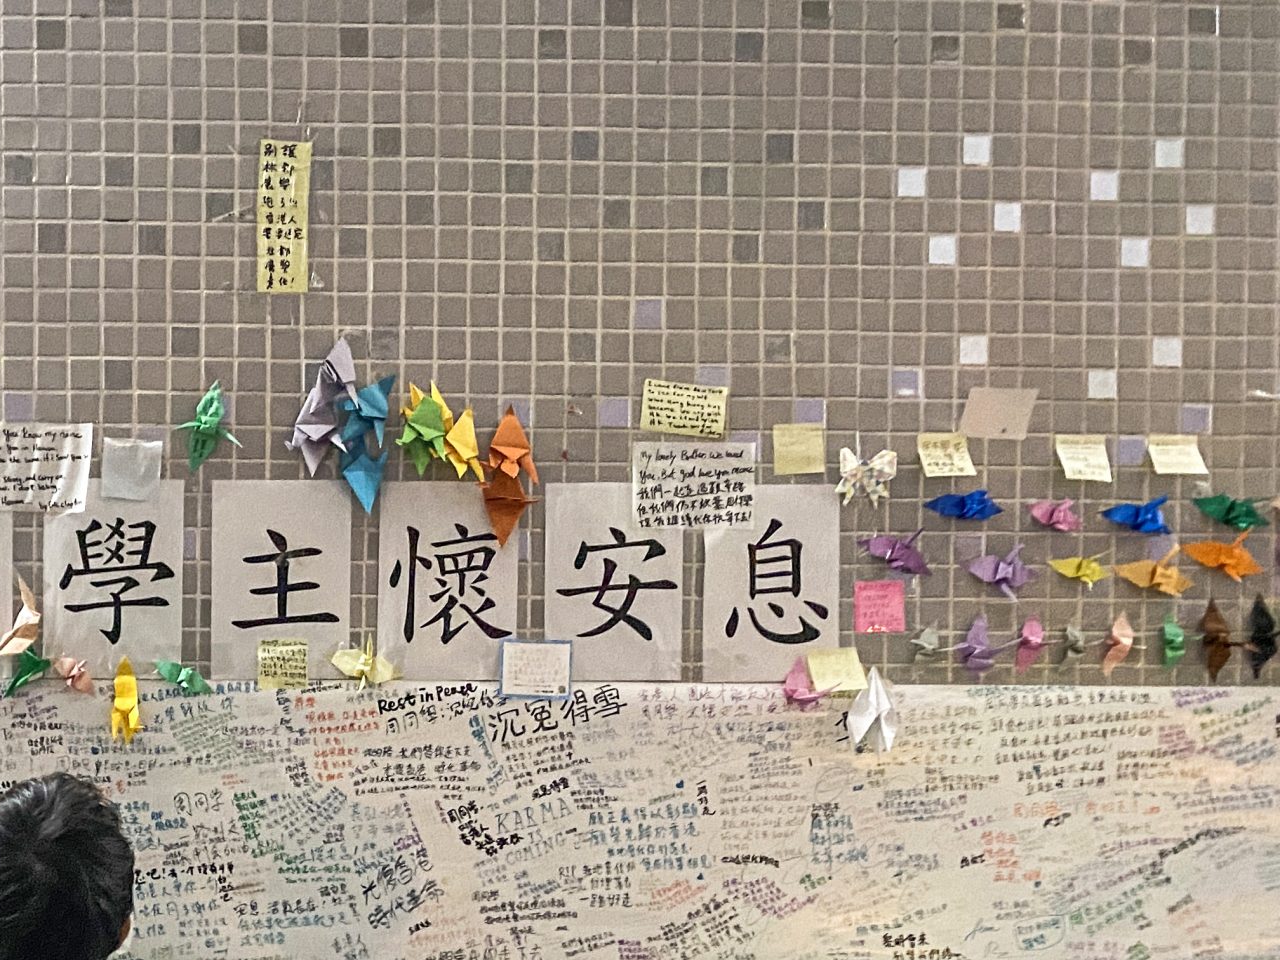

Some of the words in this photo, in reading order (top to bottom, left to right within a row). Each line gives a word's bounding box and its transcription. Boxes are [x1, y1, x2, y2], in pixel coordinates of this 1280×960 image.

[378, 694, 417, 716] Rest
[420, 688, 434, 702] in
[436, 683, 479, 703] Peace
[489, 685, 628, 743] 沉冤得雪
[495, 798, 574, 835] KARMA
[506, 832, 567, 866] COMING
